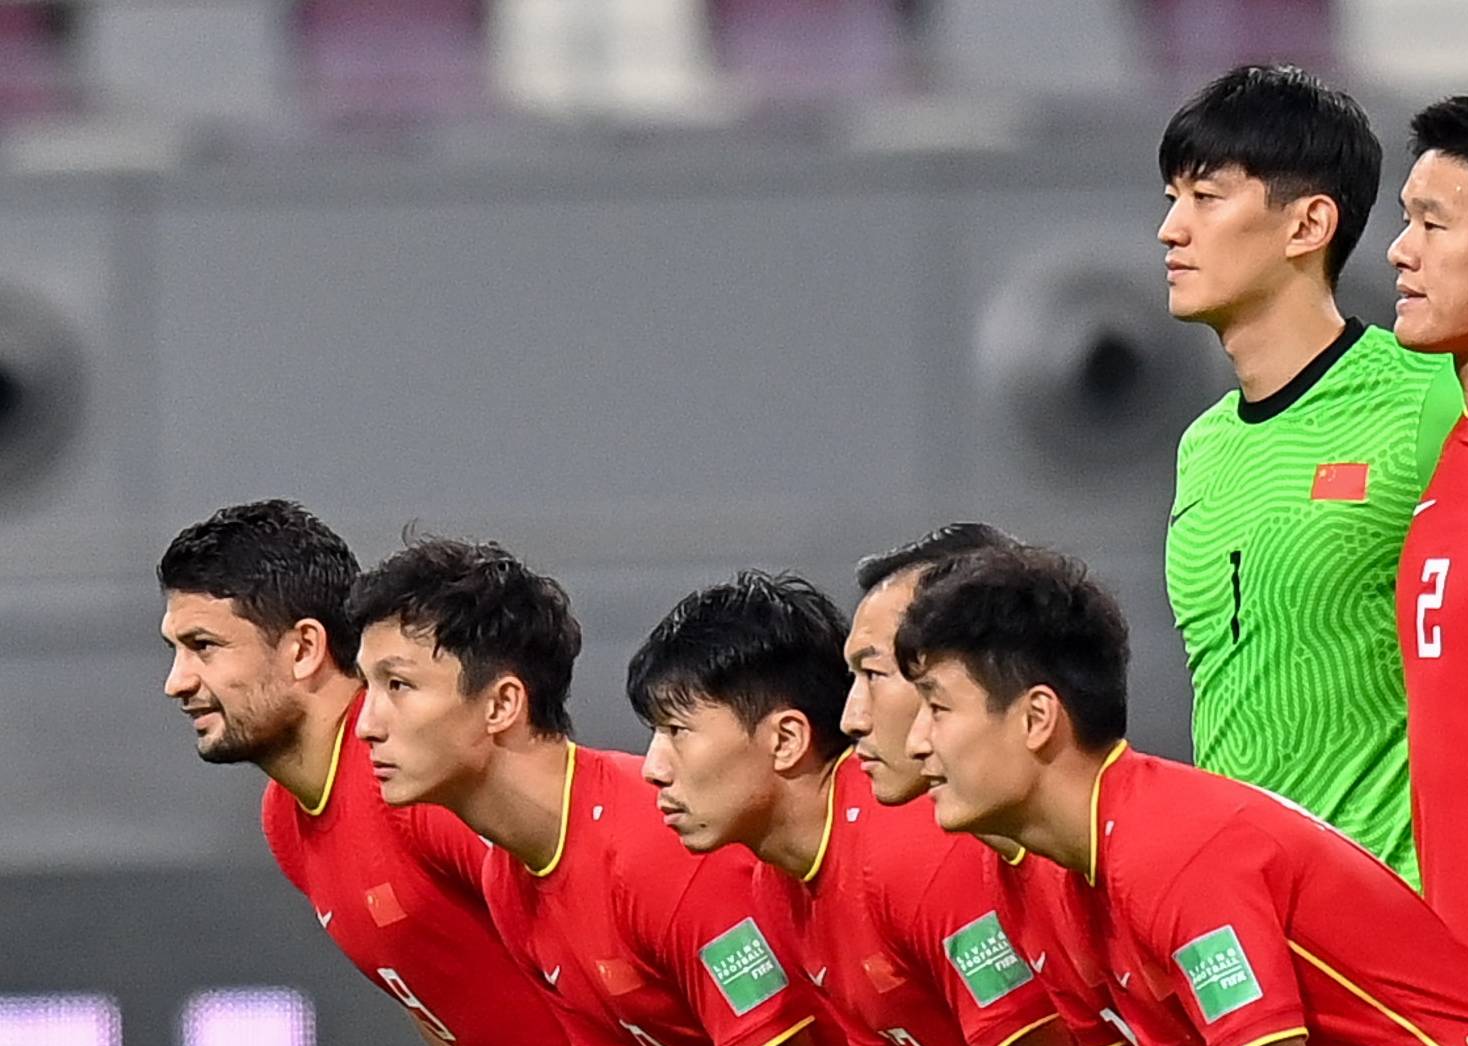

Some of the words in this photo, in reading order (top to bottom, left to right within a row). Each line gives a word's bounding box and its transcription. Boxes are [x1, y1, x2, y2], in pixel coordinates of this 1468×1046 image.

[1229, 551, 1242, 644] 1
[1415, 557, 1450, 659] 2
[376, 967, 457, 1042] 9
